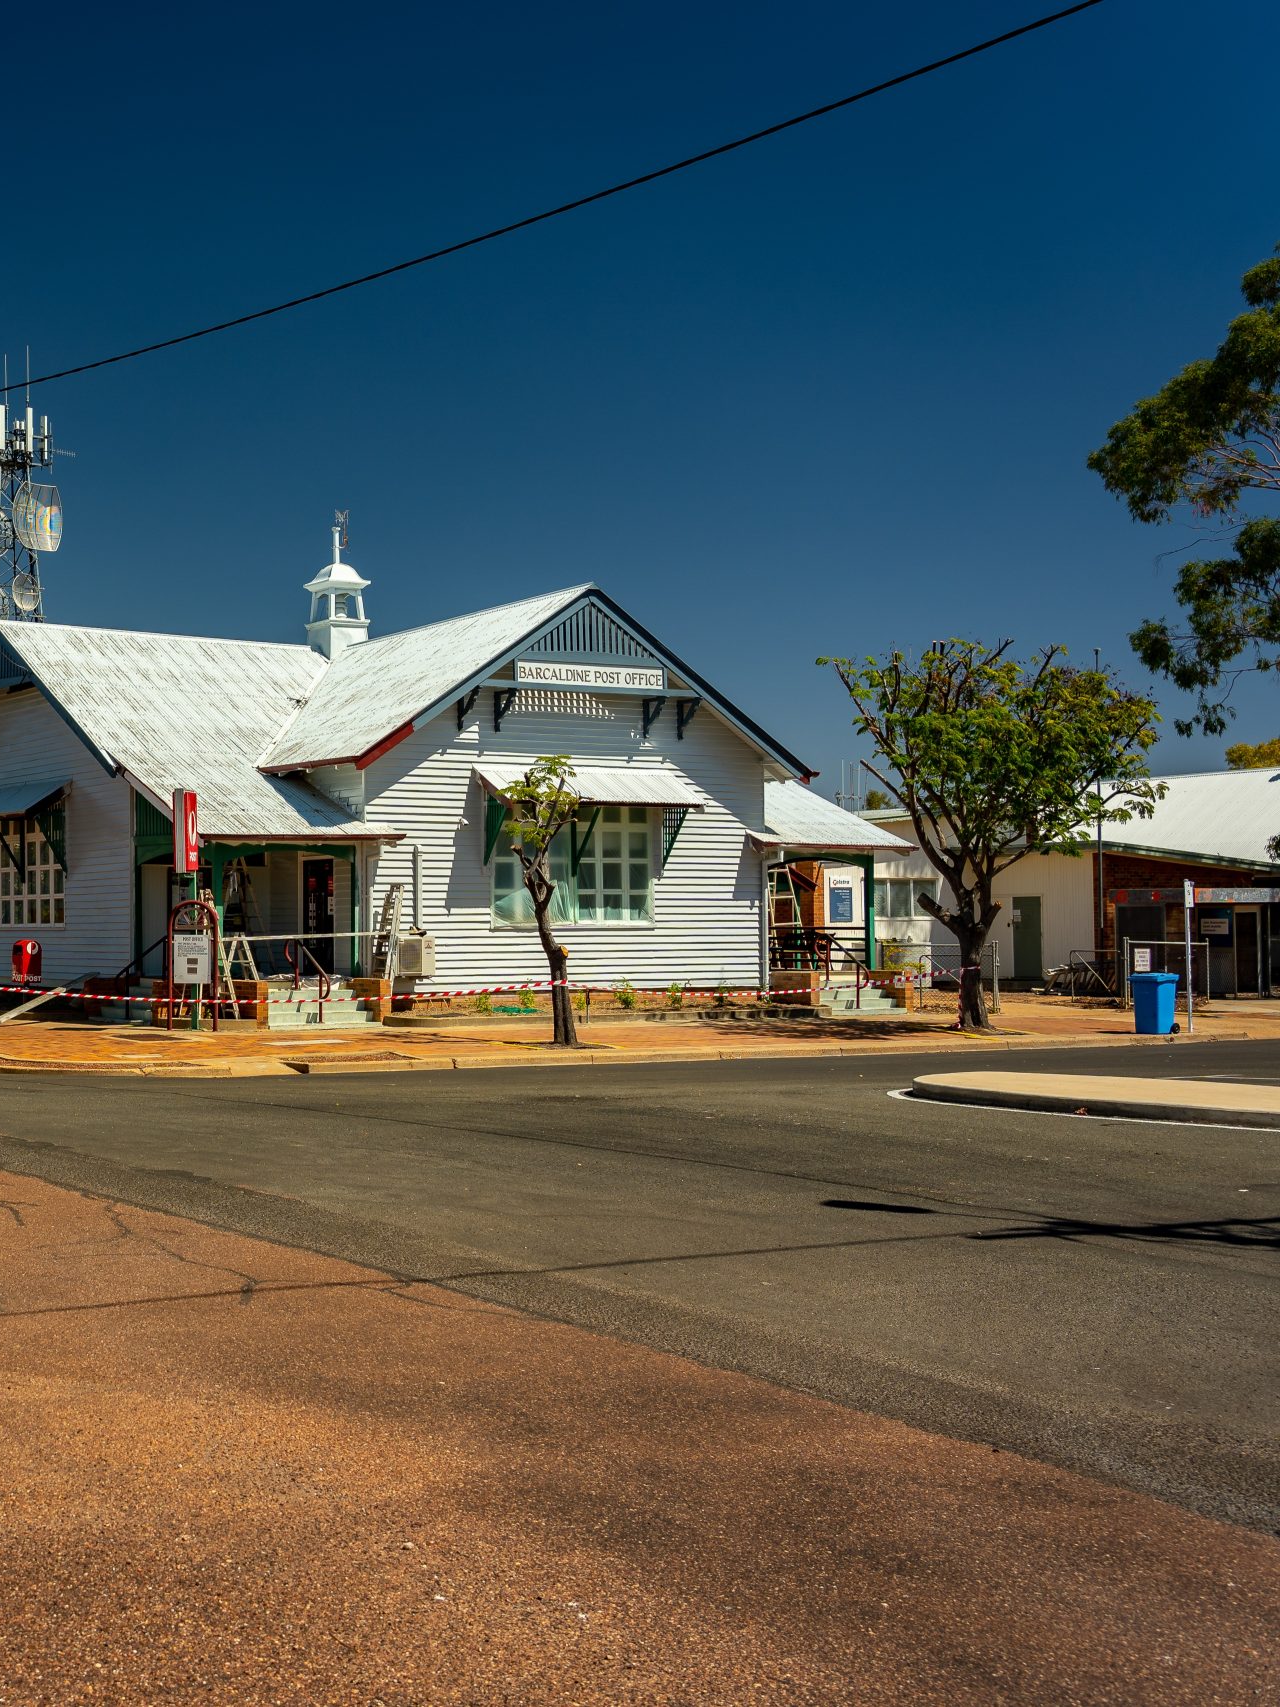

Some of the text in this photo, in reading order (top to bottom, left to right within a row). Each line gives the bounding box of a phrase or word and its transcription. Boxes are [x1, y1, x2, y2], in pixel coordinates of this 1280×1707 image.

[519, 666, 662, 686] BARCALDINE POST OFFICE
